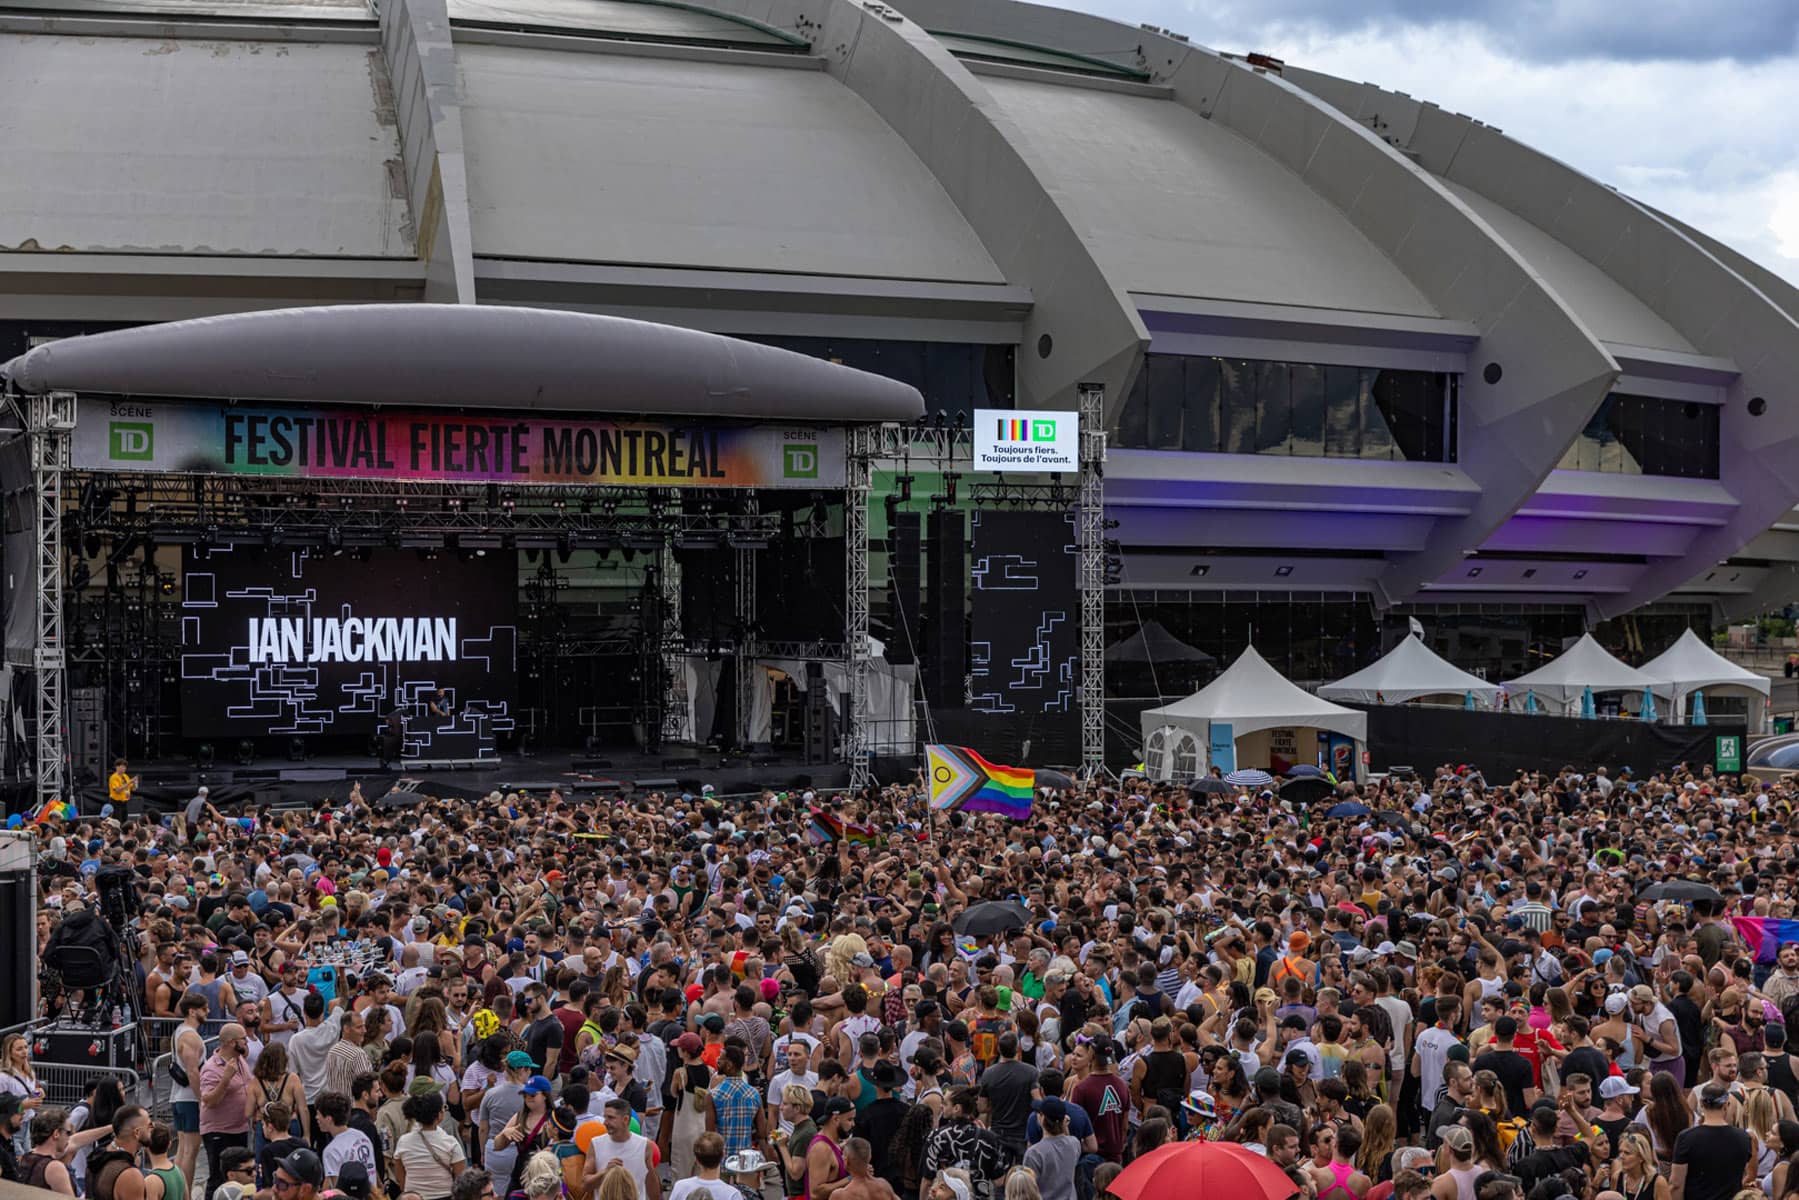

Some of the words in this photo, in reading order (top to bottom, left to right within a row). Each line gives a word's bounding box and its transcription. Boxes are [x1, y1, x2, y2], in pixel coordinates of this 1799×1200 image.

[113, 428, 150, 453] TD
[225, 415, 394, 470] FESTIVAL
[410, 422, 530, 474] FIERTÉ
[543, 426, 726, 478] MONTRÉAL
[993, 445, 1033, 455] Toujours
[1034, 446, 1058, 455] fiers.
[786, 450, 815, 472] TD
[981, 454, 1022, 464] Toujours
[1022, 456, 1035, 464] de
[249, 617, 303, 662] IAN
[308, 617, 456, 662] JACKMAN
